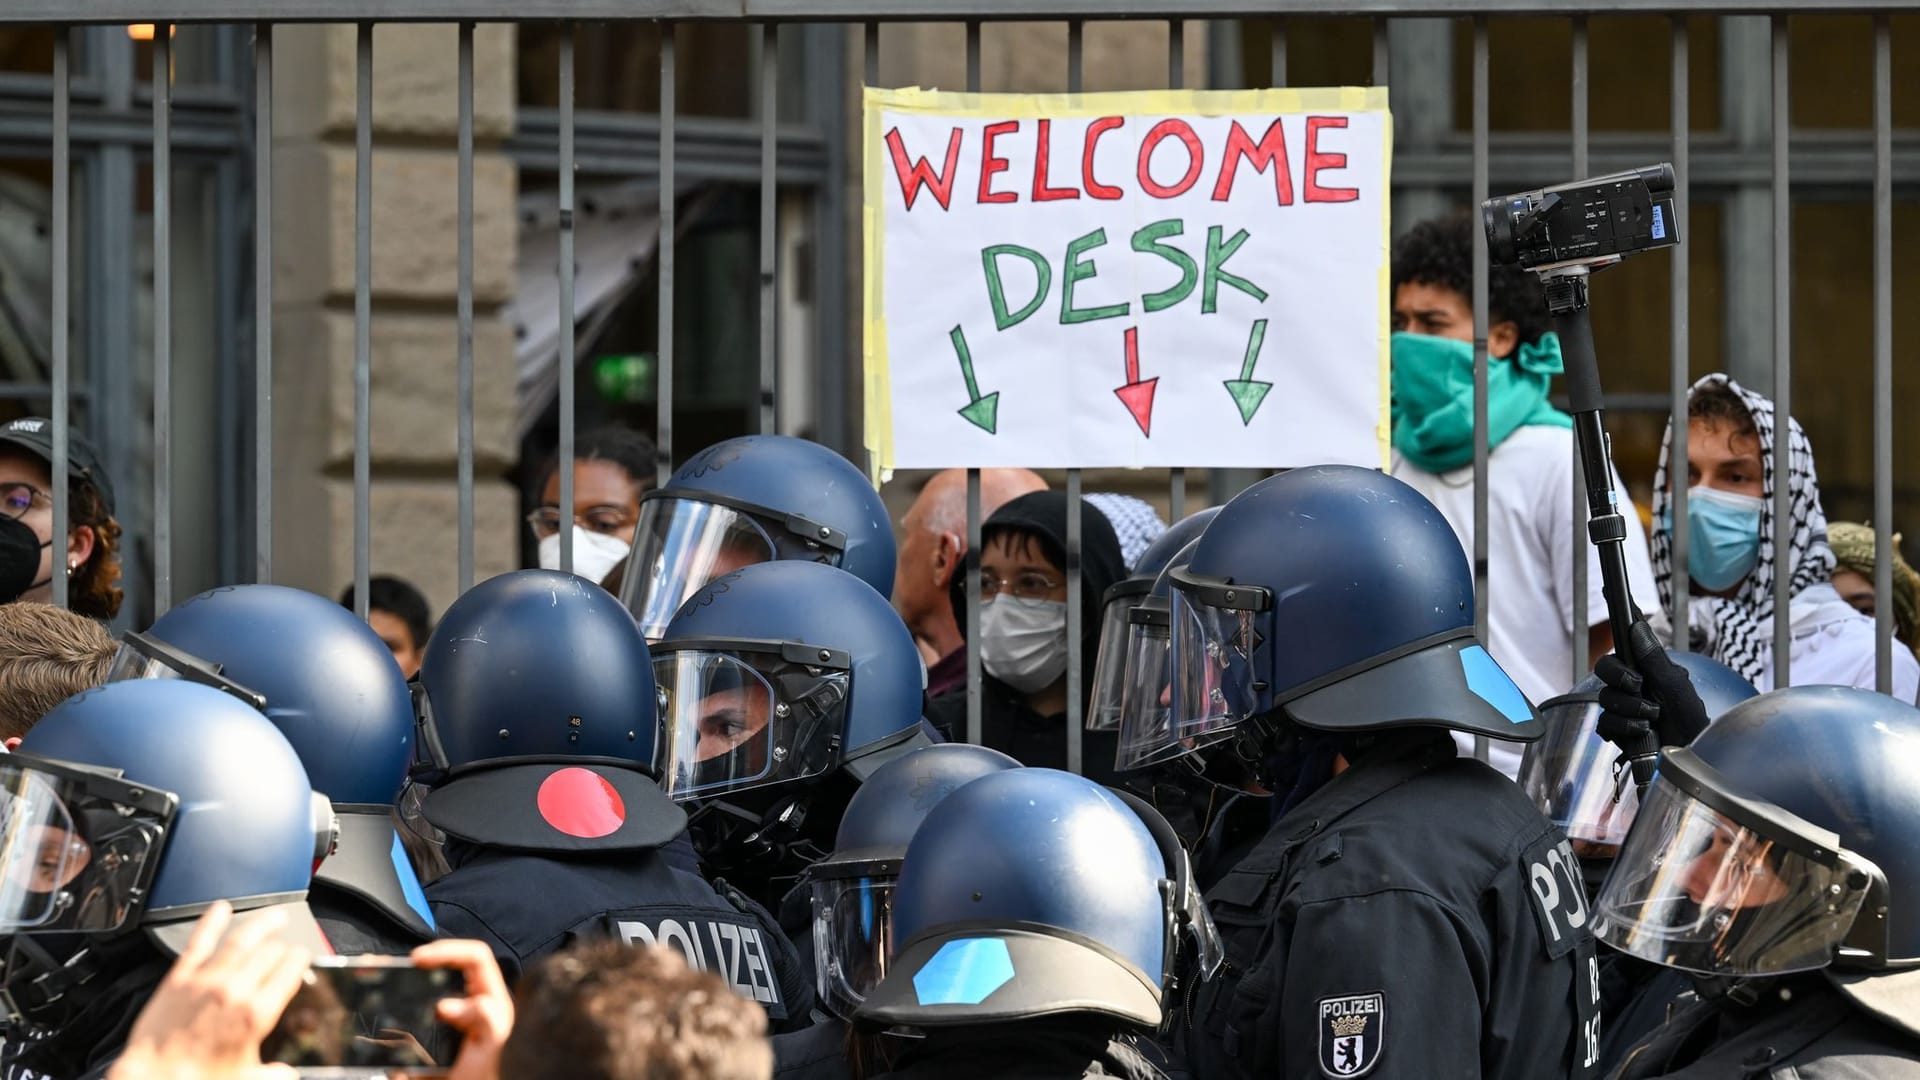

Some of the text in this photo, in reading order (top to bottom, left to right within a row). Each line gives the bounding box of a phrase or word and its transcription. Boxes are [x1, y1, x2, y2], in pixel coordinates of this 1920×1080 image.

[884, 116, 1361, 212] WELCOME
[981, 217, 1270, 332] DESK
[1322, 998, 1379, 1019] POLIZEI
